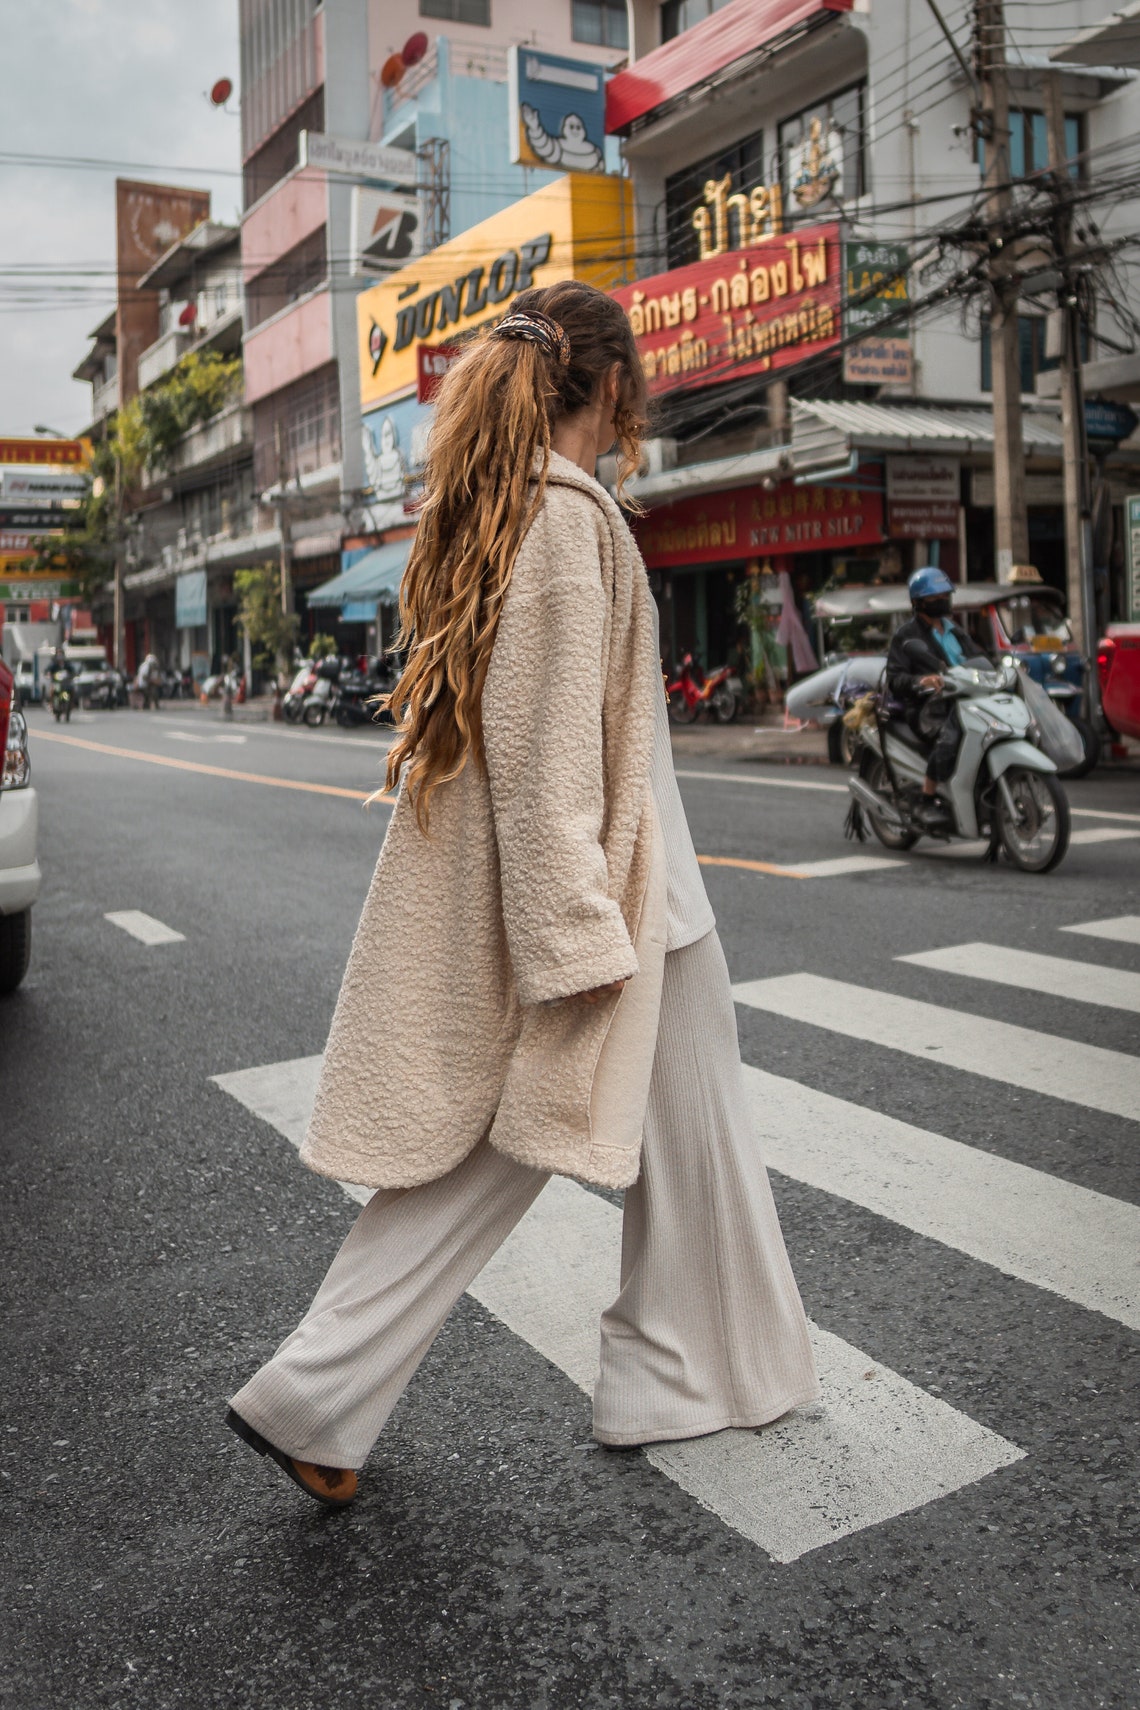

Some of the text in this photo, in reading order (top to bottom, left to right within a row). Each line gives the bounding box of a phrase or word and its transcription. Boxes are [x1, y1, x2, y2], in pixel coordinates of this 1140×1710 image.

[692, 172, 782, 260] ป้าย
[392, 233, 553, 352] DUNLOP
[750, 526, 779, 547] NEW
[827, 515, 863, 537] SILP
